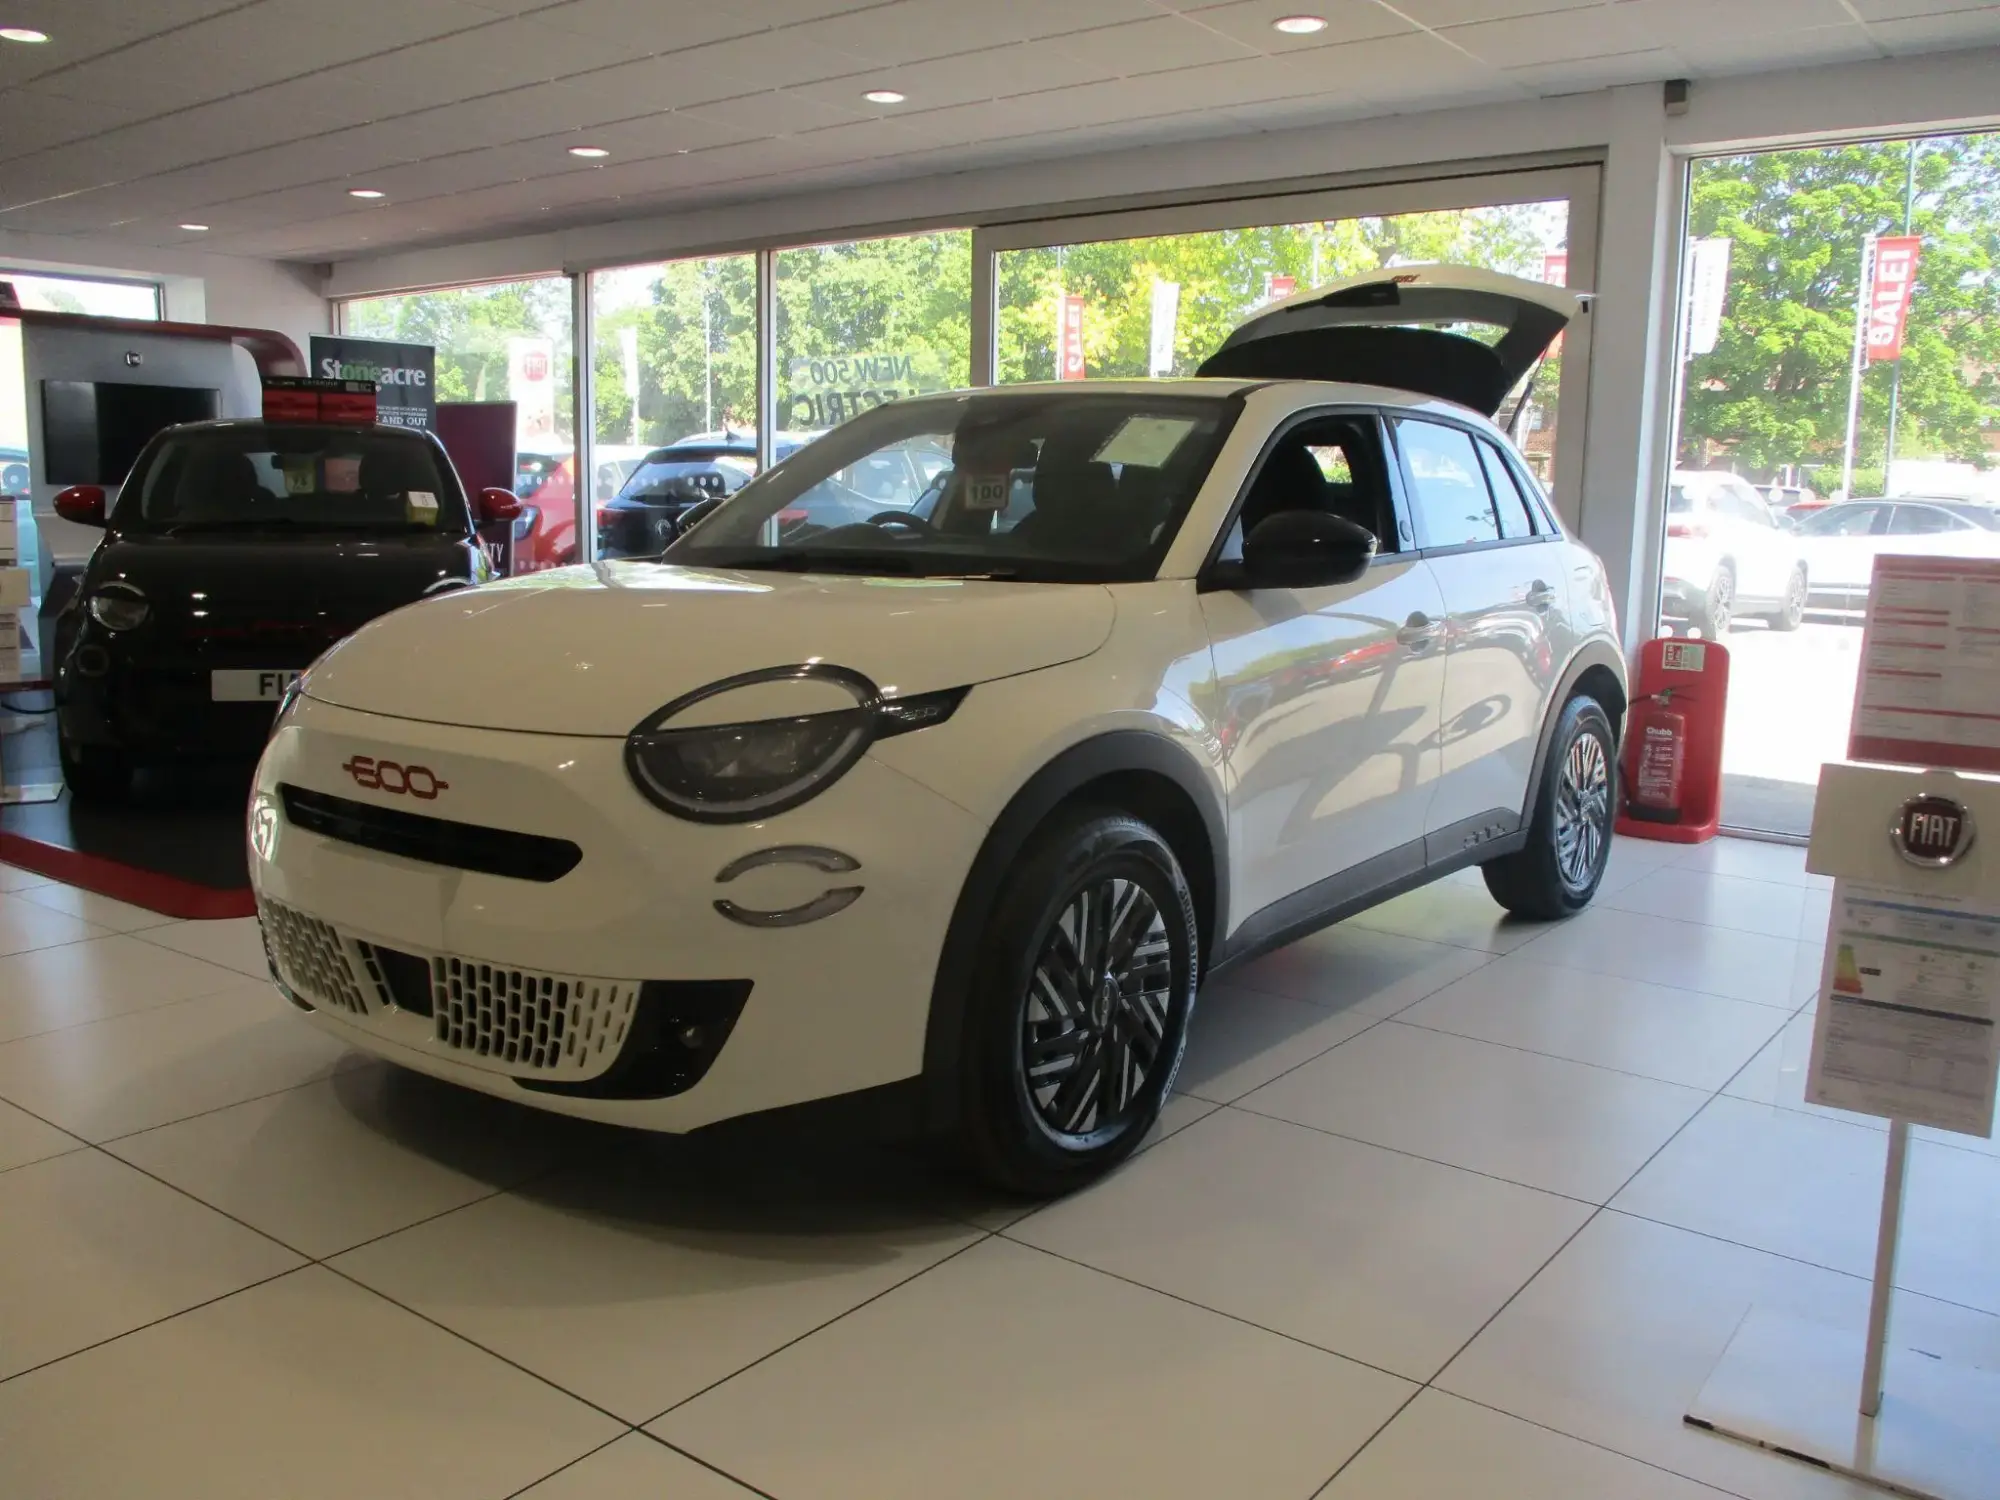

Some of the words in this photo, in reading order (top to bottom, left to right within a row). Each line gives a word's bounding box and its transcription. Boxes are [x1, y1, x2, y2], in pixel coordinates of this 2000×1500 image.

[321, 357, 426, 387] Stoneacre
[382, 415, 404, 425] AND
[406, 416, 427, 427] OUT
[1646, 726, 1673, 736] Chubb
[1908, 812, 1959, 848] FIAT
